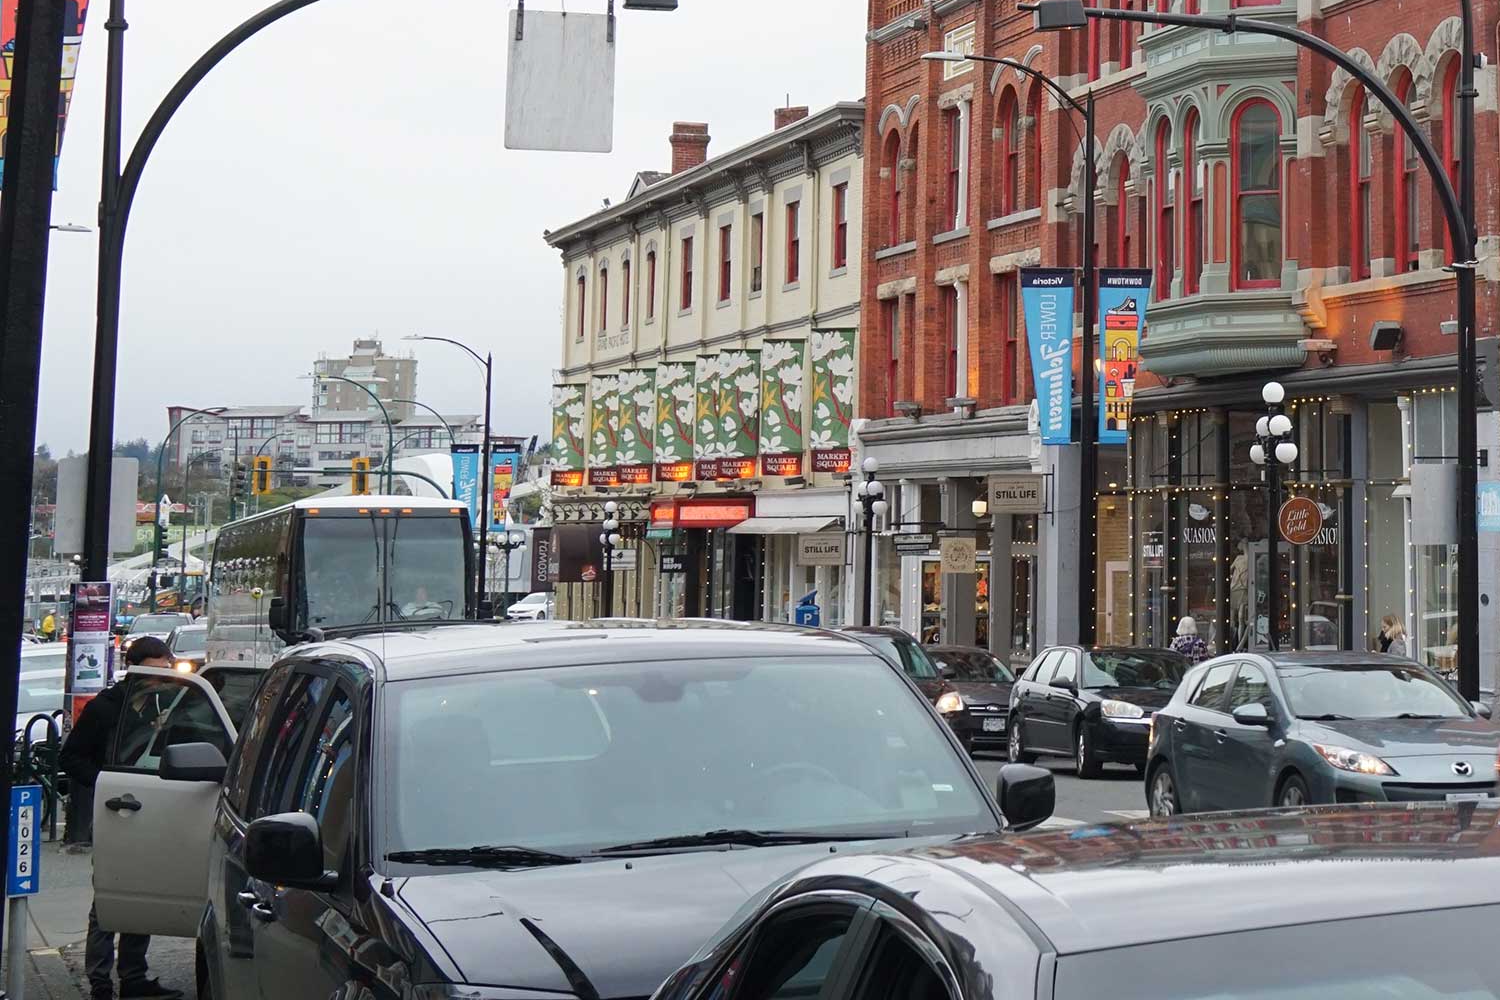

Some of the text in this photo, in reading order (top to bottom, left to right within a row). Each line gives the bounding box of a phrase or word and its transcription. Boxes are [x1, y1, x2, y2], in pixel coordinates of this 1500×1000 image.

[766, 464, 797, 472] SQUARE
[816, 460, 849, 468] SQUARE
[995, 490, 1037, 499] STILL LIFE
[1287, 509, 1309, 521] Little
[1286, 519, 1307, 534] Gold
[1183, 527, 1216, 544] SUASION
[804, 545, 839, 554] STILL LIFE
[803, 613, 812, 625] P
[21, 791, 30, 804] P
[19, 808, 30, 873] 4026
